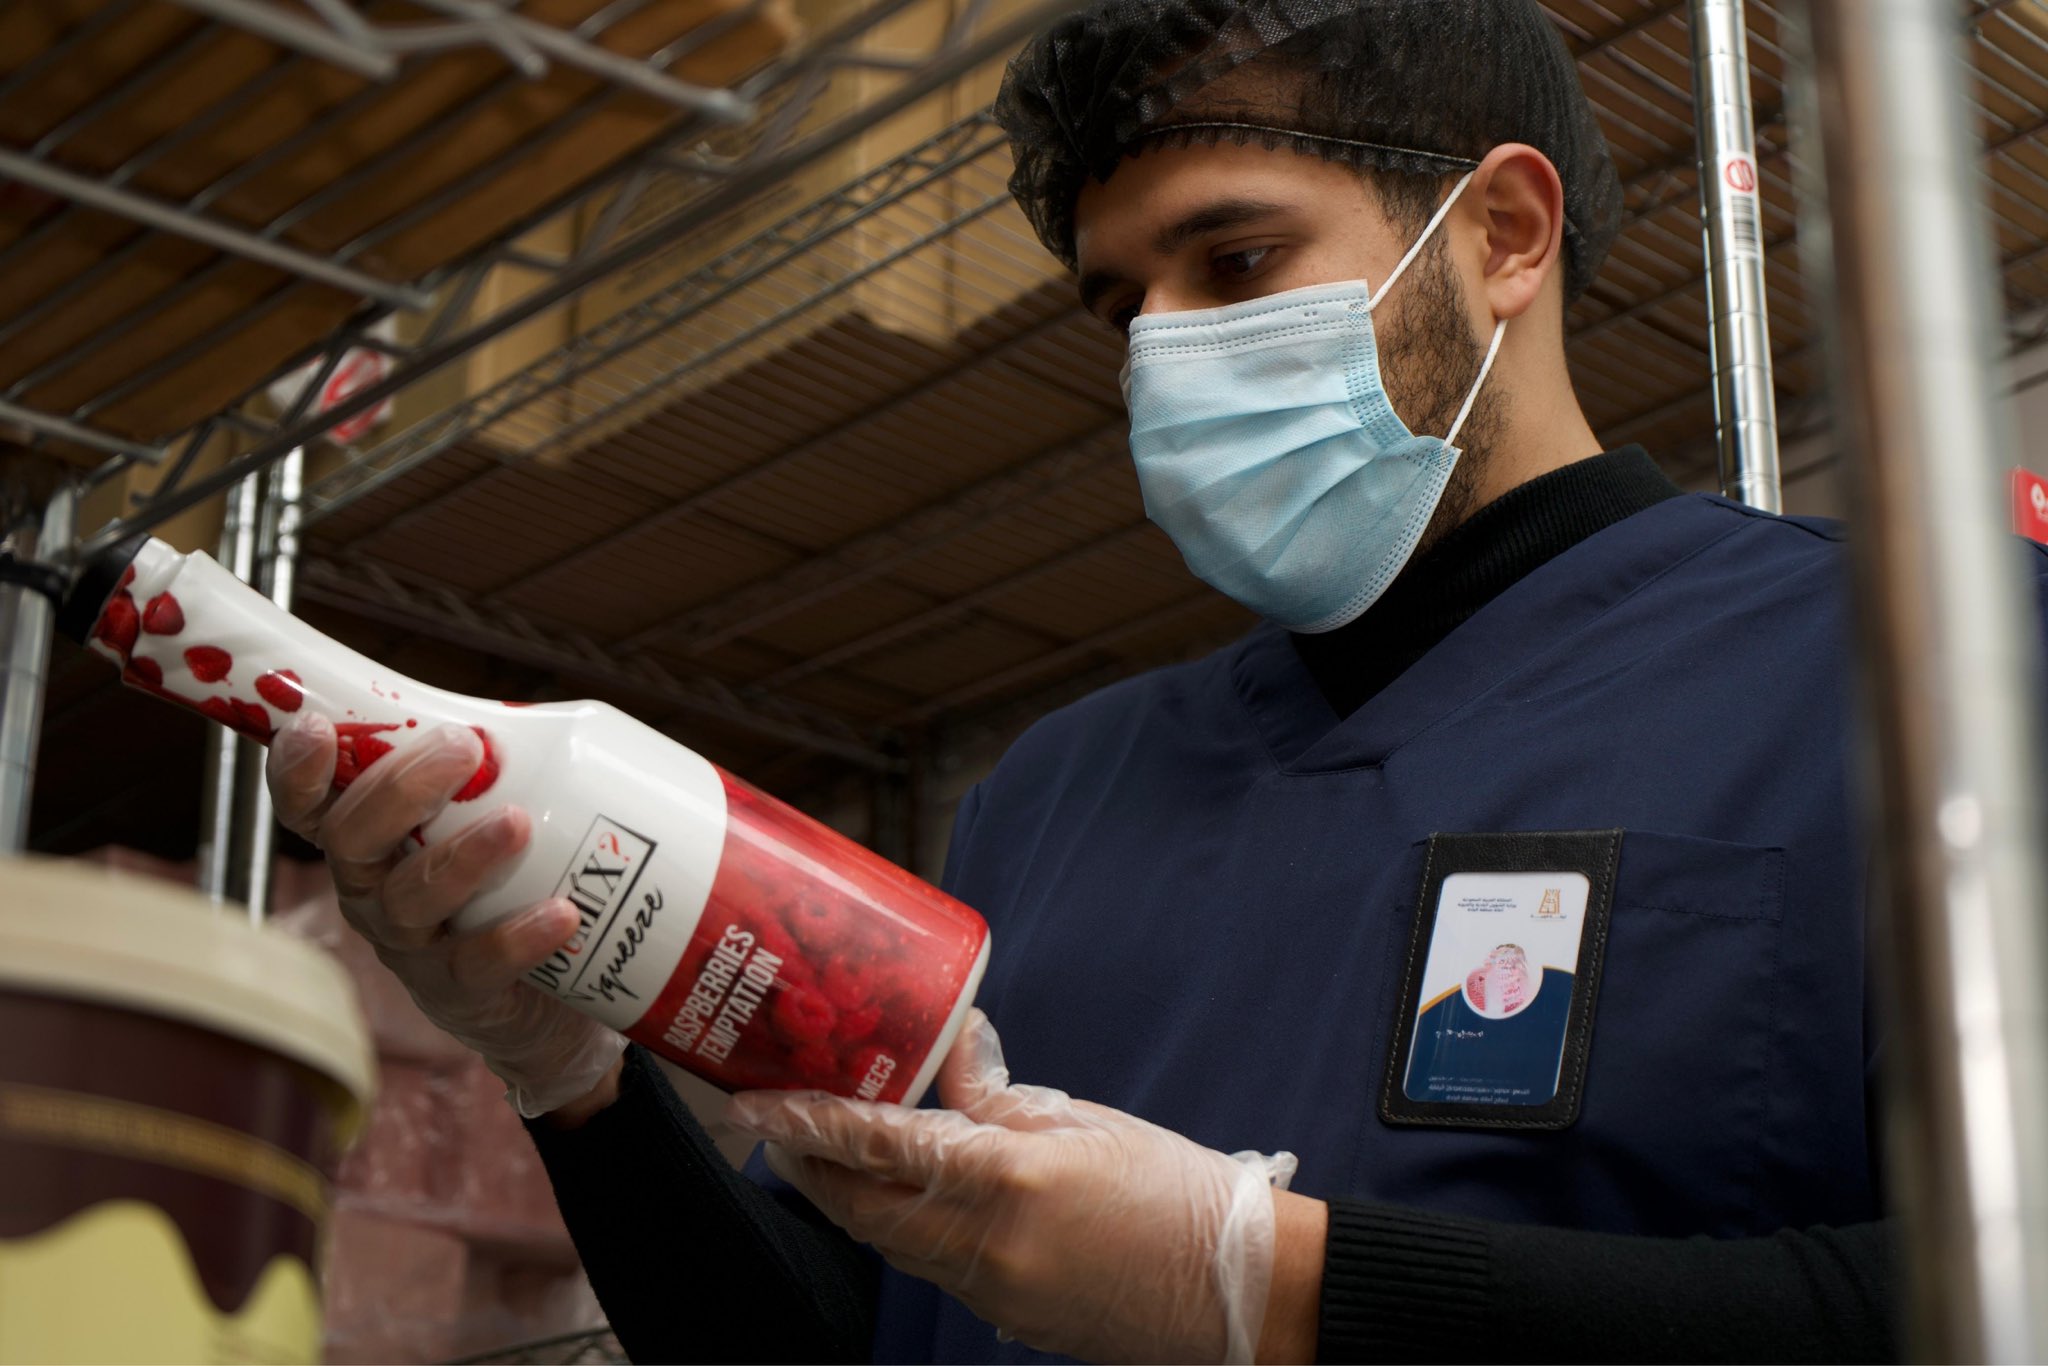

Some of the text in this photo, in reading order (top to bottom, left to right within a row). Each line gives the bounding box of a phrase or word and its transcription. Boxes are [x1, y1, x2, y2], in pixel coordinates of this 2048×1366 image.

[663, 924, 755, 1052] RASPBERRIES
[696, 947, 784, 1065] TEMPTATION
[856, 1054, 896, 1100] MEC3
